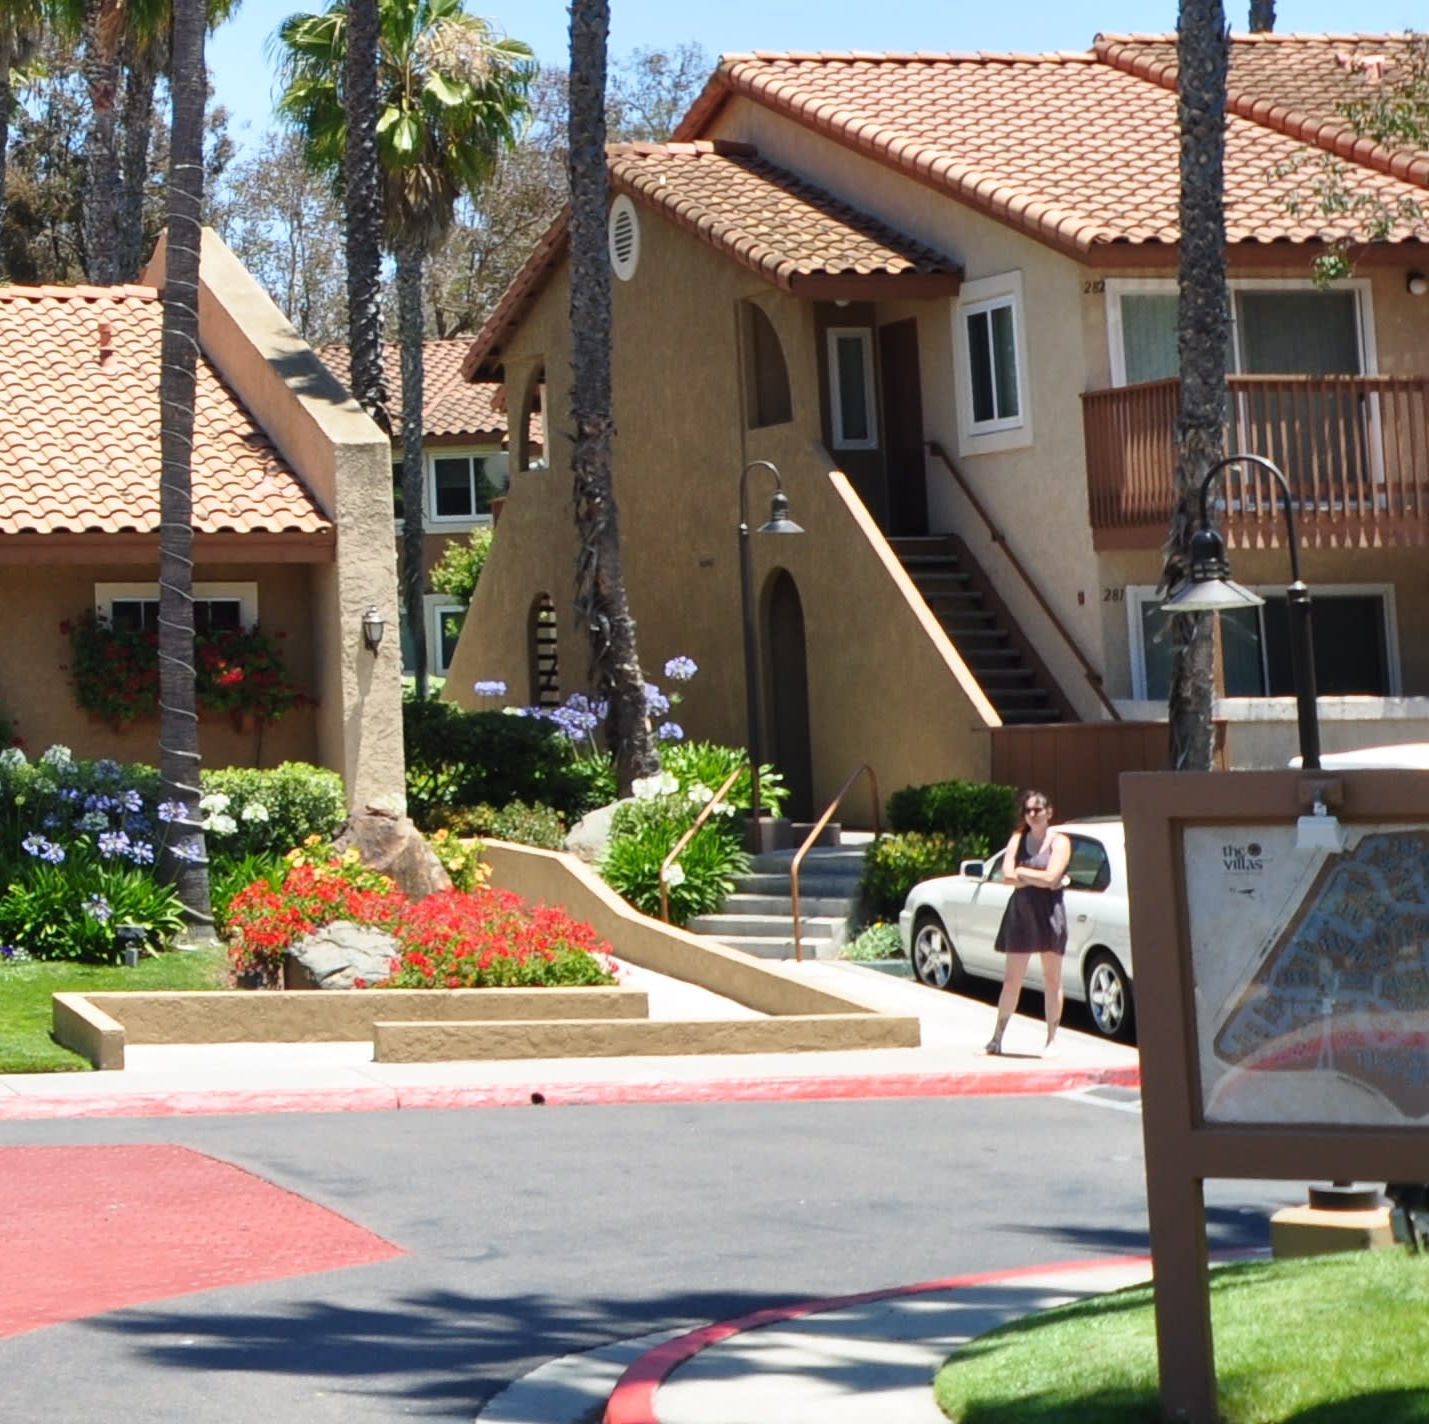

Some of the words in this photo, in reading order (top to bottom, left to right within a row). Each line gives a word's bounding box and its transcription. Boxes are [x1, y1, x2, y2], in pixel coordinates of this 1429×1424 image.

[1103, 588, 1125, 602] 281
[1223, 845, 1245, 857] the
[1223, 856, 1263, 871] villas
